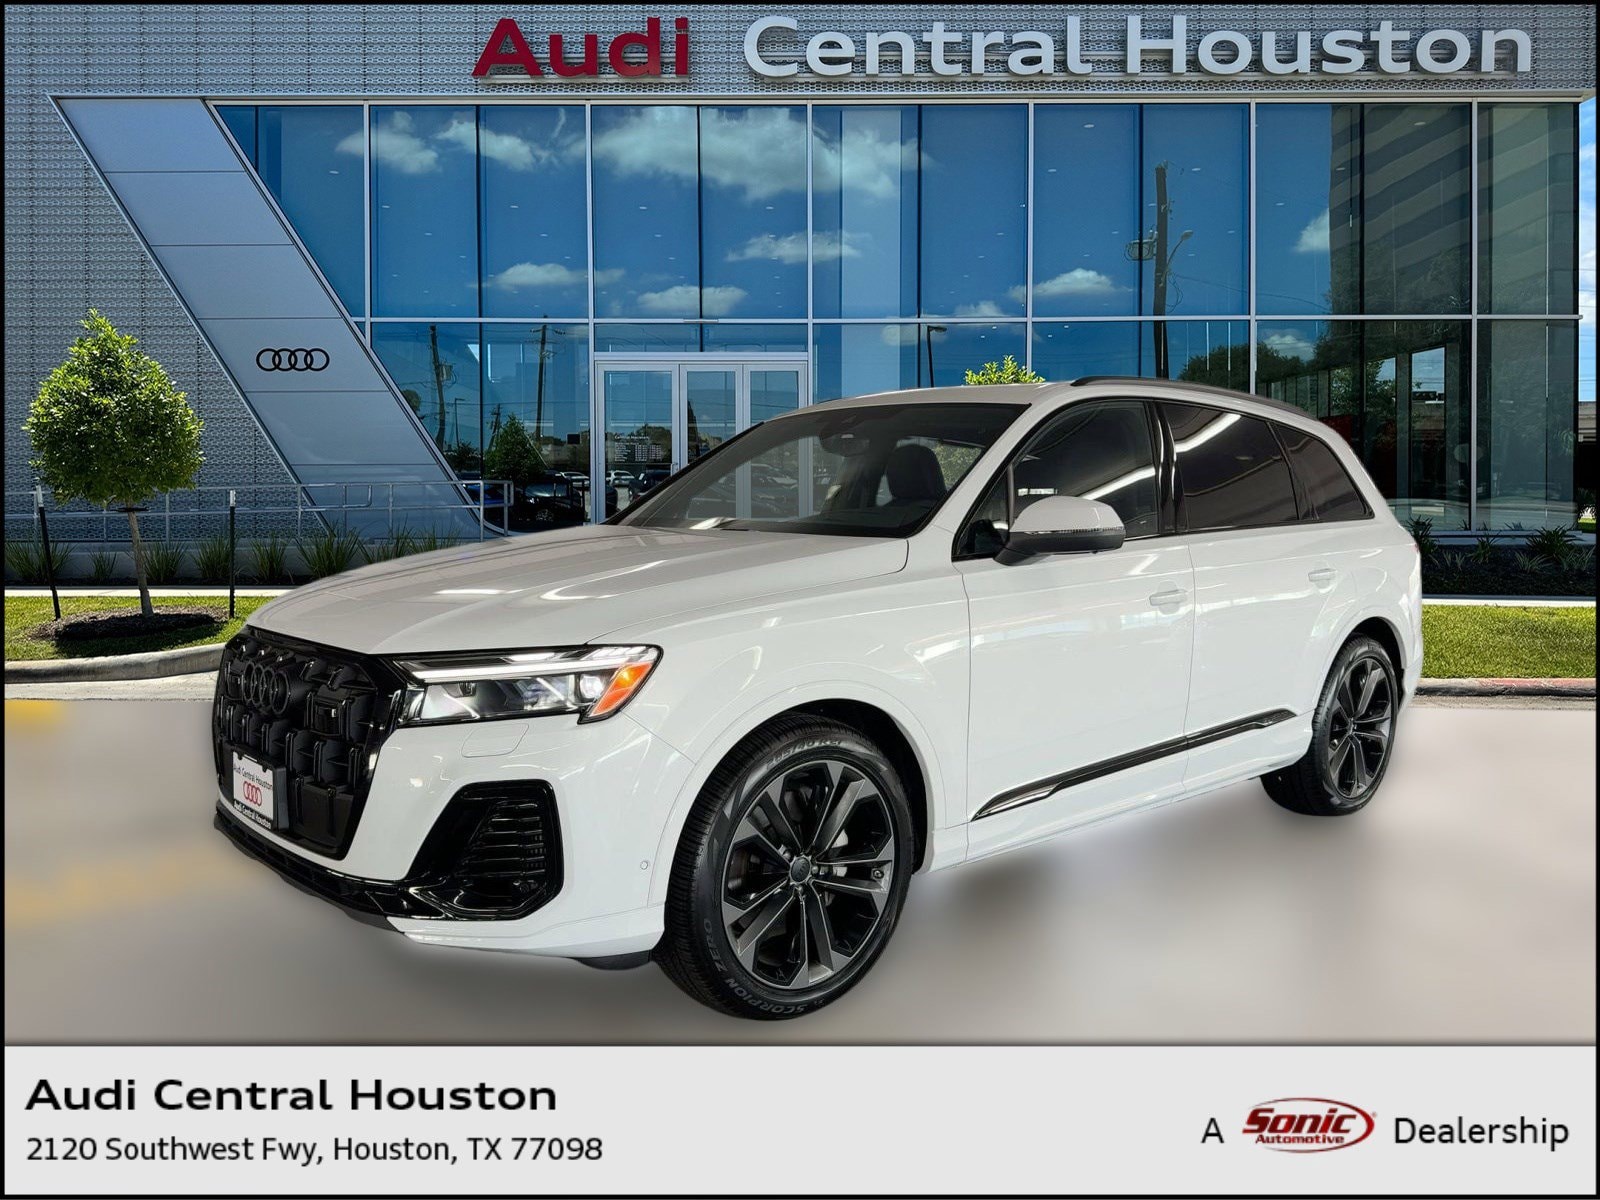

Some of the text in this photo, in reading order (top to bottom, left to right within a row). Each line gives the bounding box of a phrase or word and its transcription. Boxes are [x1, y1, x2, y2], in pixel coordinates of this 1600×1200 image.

[472, 15, 1533, 77] Audi Central Houston
[703, 919, 808, 1014] SCORPION ZERO
